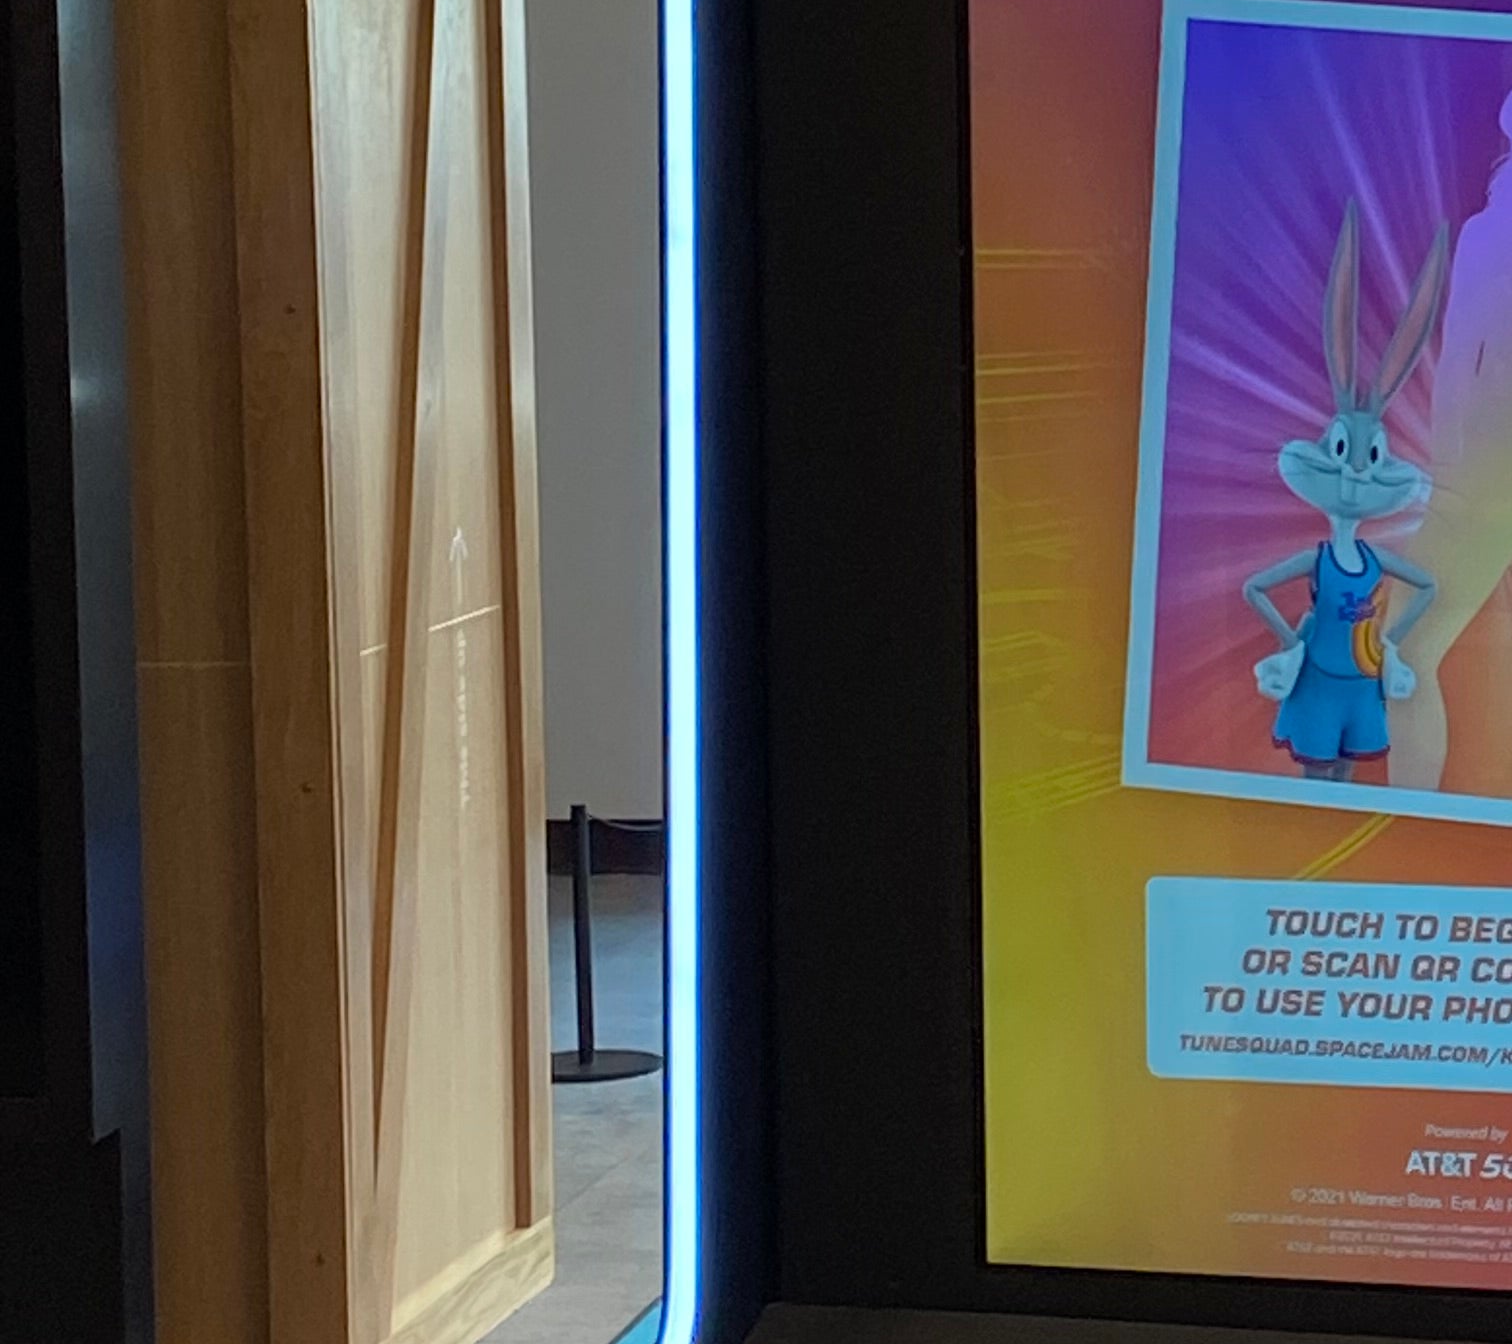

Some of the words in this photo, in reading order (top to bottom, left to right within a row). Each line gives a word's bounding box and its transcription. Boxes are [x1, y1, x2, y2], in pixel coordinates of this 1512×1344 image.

[1265, 907, 1385, 940] TOUCH
[1395, 912, 1439, 943] TO
[1241, 948, 1293, 976] OR
[1301, 950, 1402, 981] SCAN
[1409, 954, 1462, 983] QR
[1203, 985, 1246, 1014] TO
[1255, 988, 1327, 1018] USE
[1336, 991, 1434, 1021] YOUR
[1405, 1149, 1478, 1178] AT&T
[1308, 1187, 1345, 1205] 2021
[1349, 1189, 1405, 1207] Warner
